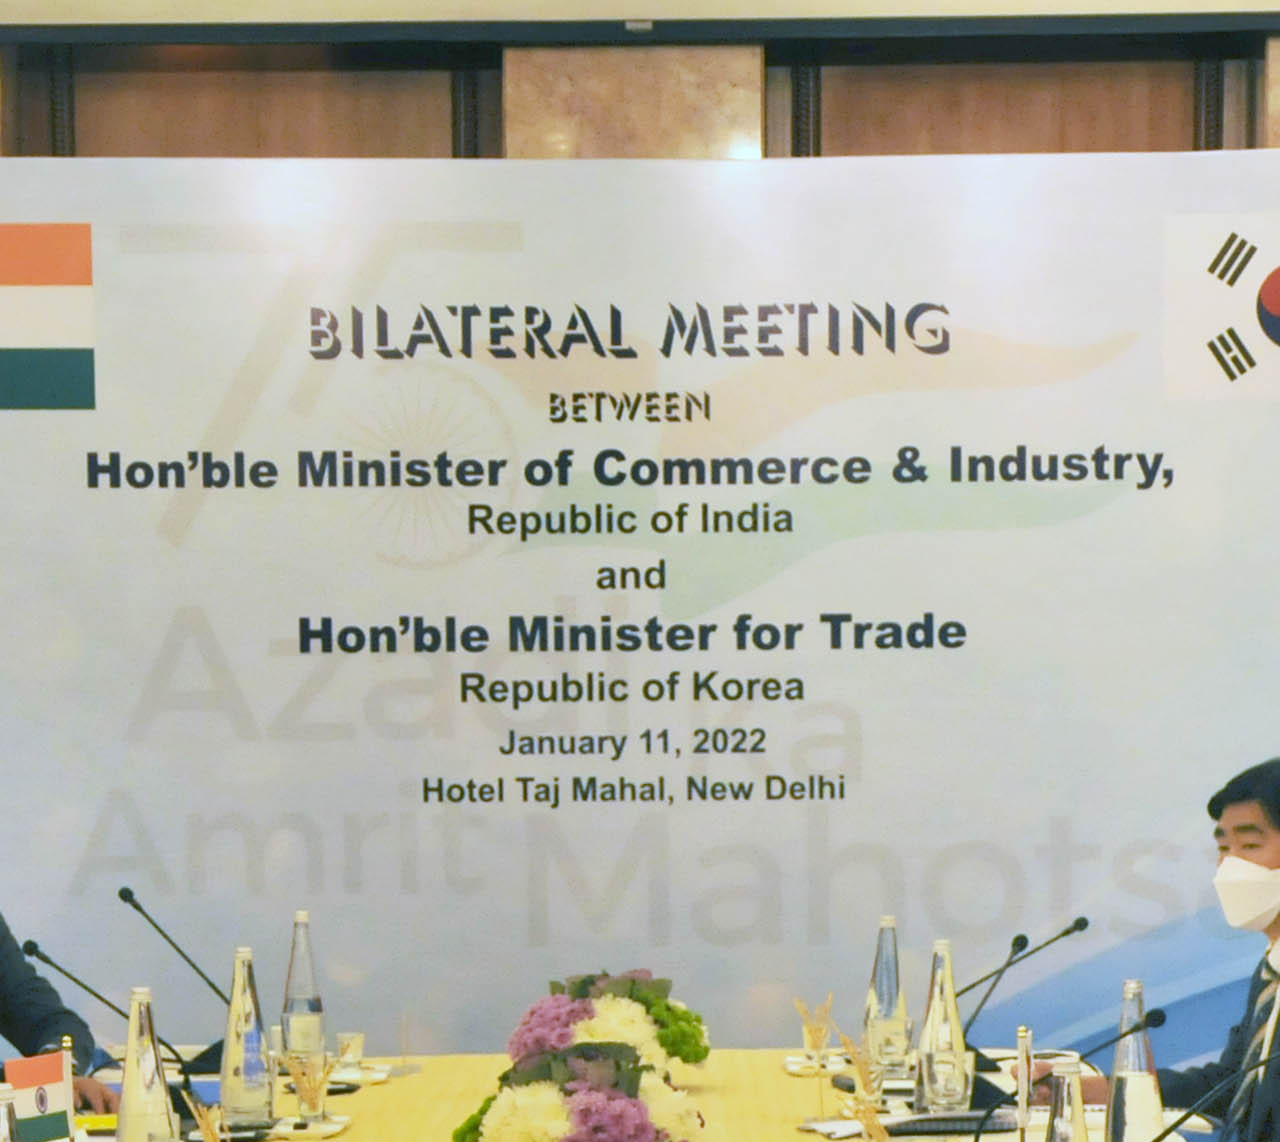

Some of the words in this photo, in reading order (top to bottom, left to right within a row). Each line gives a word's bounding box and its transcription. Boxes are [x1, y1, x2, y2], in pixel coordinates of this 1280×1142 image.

[310, 302, 638, 360] BILATERAL
[659, 301, 951, 357] MEETING
[548, 390, 712, 423] BETWEEN
[298, 451, 507, 487] Minister
[524, 450, 574, 486] of
[594, 449, 871, 486] Commerce
[893, 446, 928, 483] &
[951, 445, 1174, 491] Industry,
[469, 504, 637, 542] Republic
[651, 503, 689, 533] of
[702, 503, 792, 533] India
[597, 559, 665, 589] and
[509, 616, 717, 652] Minister
[733, 614, 803, 650] for
[820, 613, 966, 649] Trade
[461, 672, 628, 710] Republic
[643, 671, 680, 702] of
[693, 671, 804, 701] Korea
[498, 730, 628, 761] January
[640, 729, 681, 758] 11,
[693, 729, 766, 754] 2022
[422, 777, 504, 803] Hotel
[516, 777, 561, 808] Taj
[572, 776, 674, 806] Mahal,
[687, 775, 754, 802] New
[765, 774, 846, 801] Delhi
